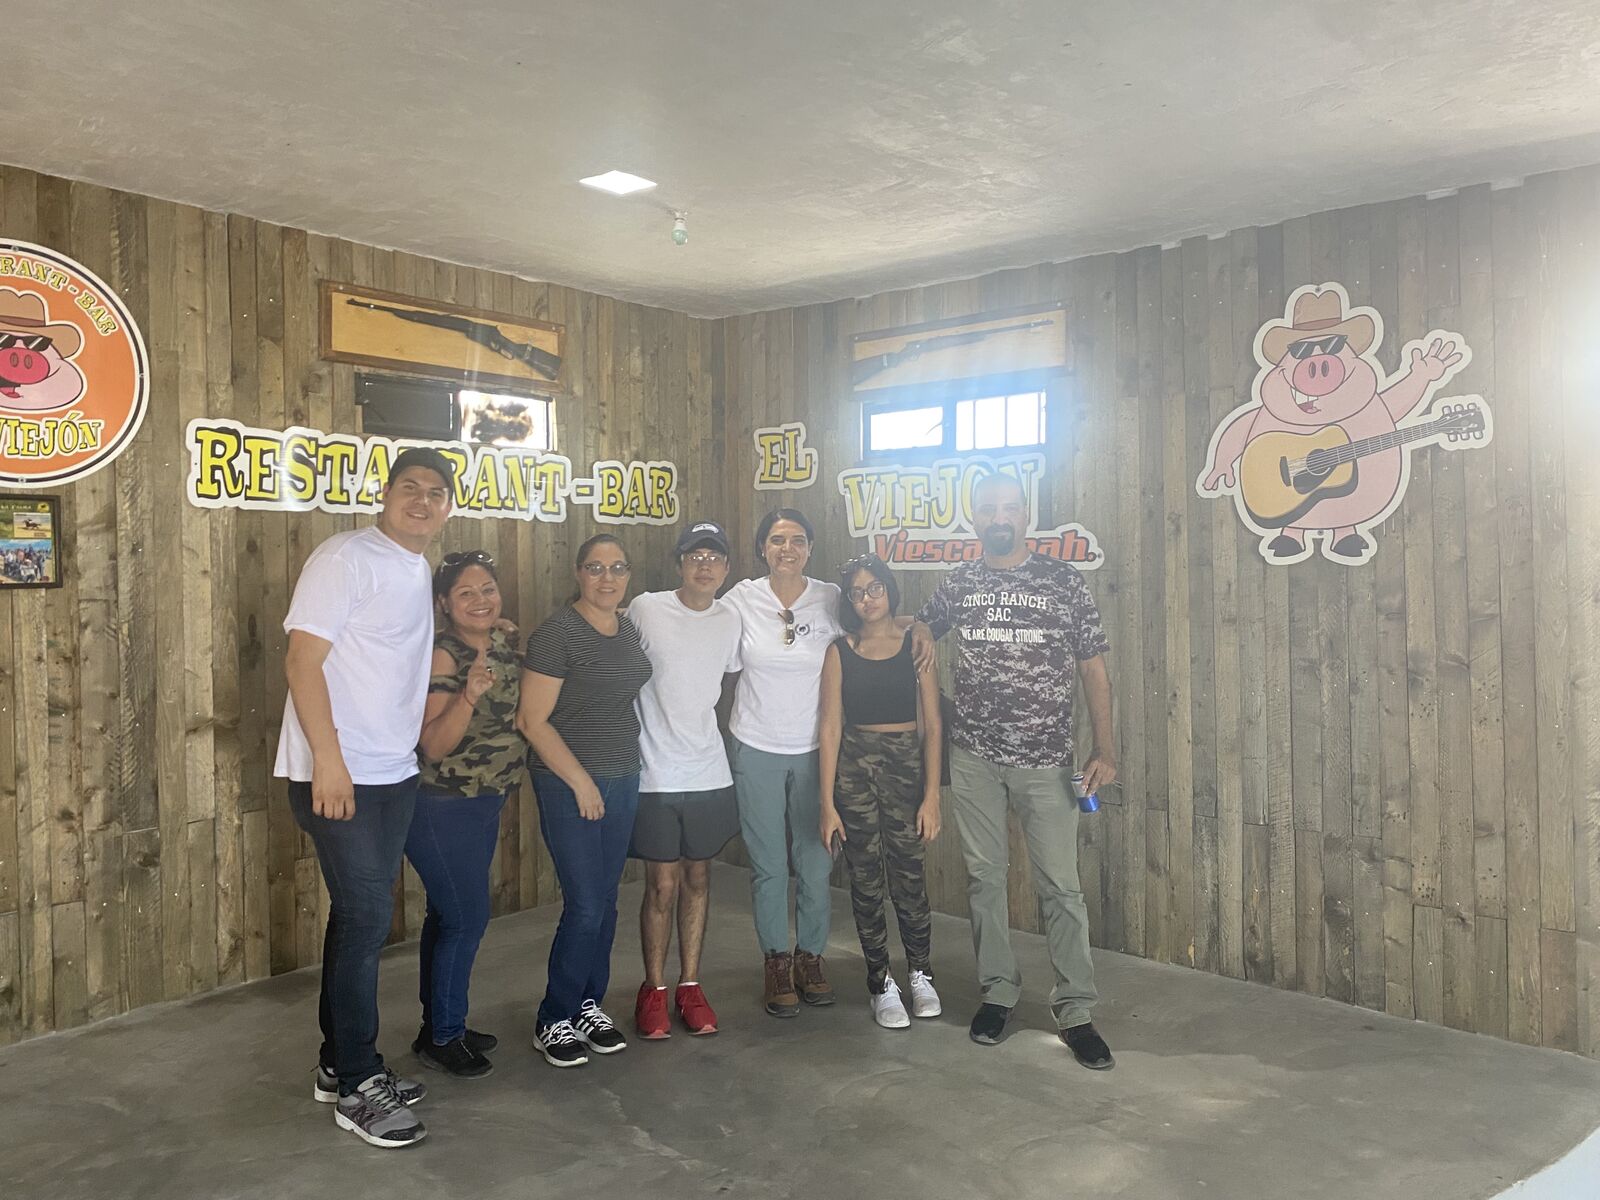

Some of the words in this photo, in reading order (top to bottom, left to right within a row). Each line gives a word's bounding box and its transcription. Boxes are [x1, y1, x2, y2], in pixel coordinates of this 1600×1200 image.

[75, 292, 117, 334] BAR
[0, 412, 101, 456] IEJÓN
[195, 427, 566, 514] RESTARANT
[599, 466, 676, 519] BAR
[759, 428, 812, 483] EL
[874, 529, 983, 562] Viesca
[962, 593, 996, 607] CINCO
[1000, 591, 1048, 610] RANCH
[986, 607, 1012, 621] SAC
[960, 627, 972, 640] WE
[972, 628, 986, 640] ARE
[986, 627, 1014, 642] COUGAR
